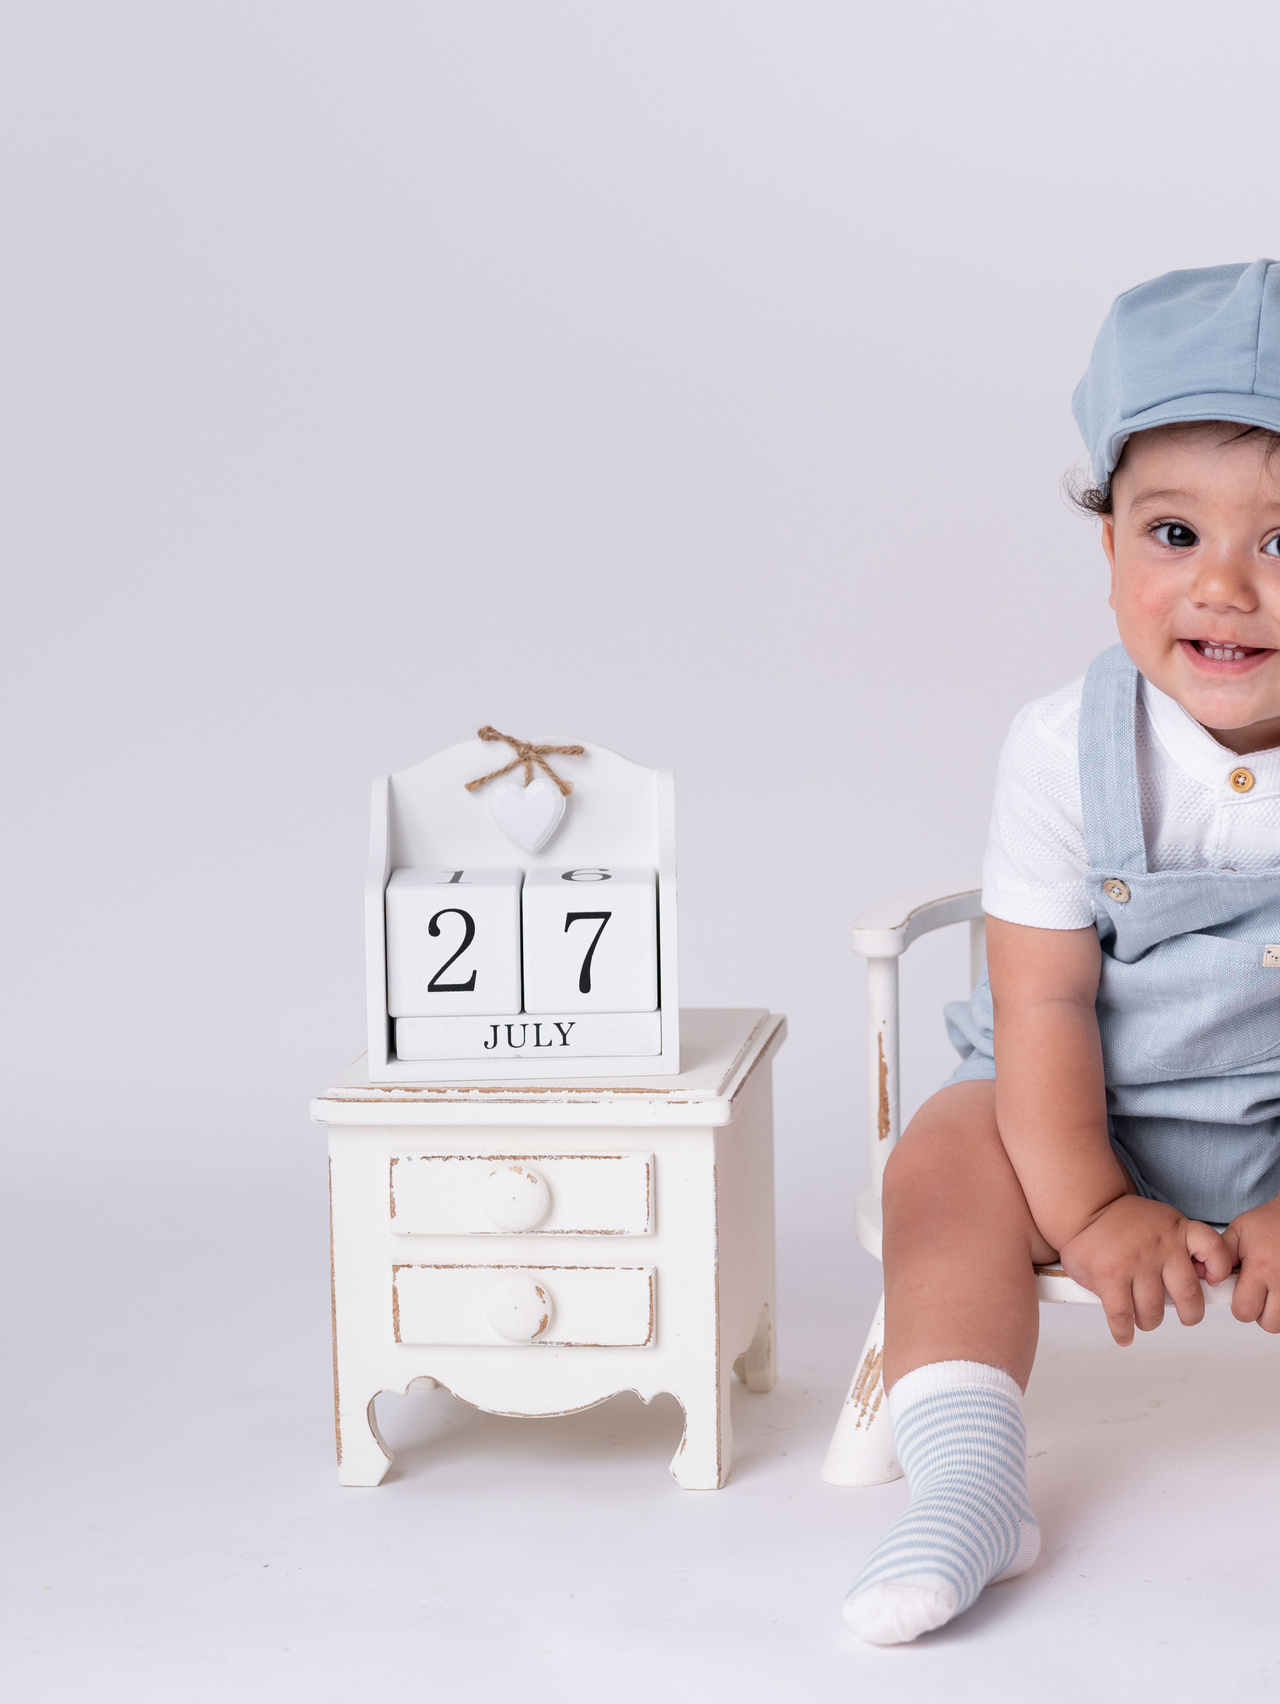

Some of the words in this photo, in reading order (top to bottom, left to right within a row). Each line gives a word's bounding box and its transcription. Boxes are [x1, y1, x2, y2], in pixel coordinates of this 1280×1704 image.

[435, 870, 471, 884] 1
[561, 868, 612, 882] 6
[427, 908, 478, 993] 2
[564, 911, 612, 994] 7
[483, 1021, 576, 1050] JULY
